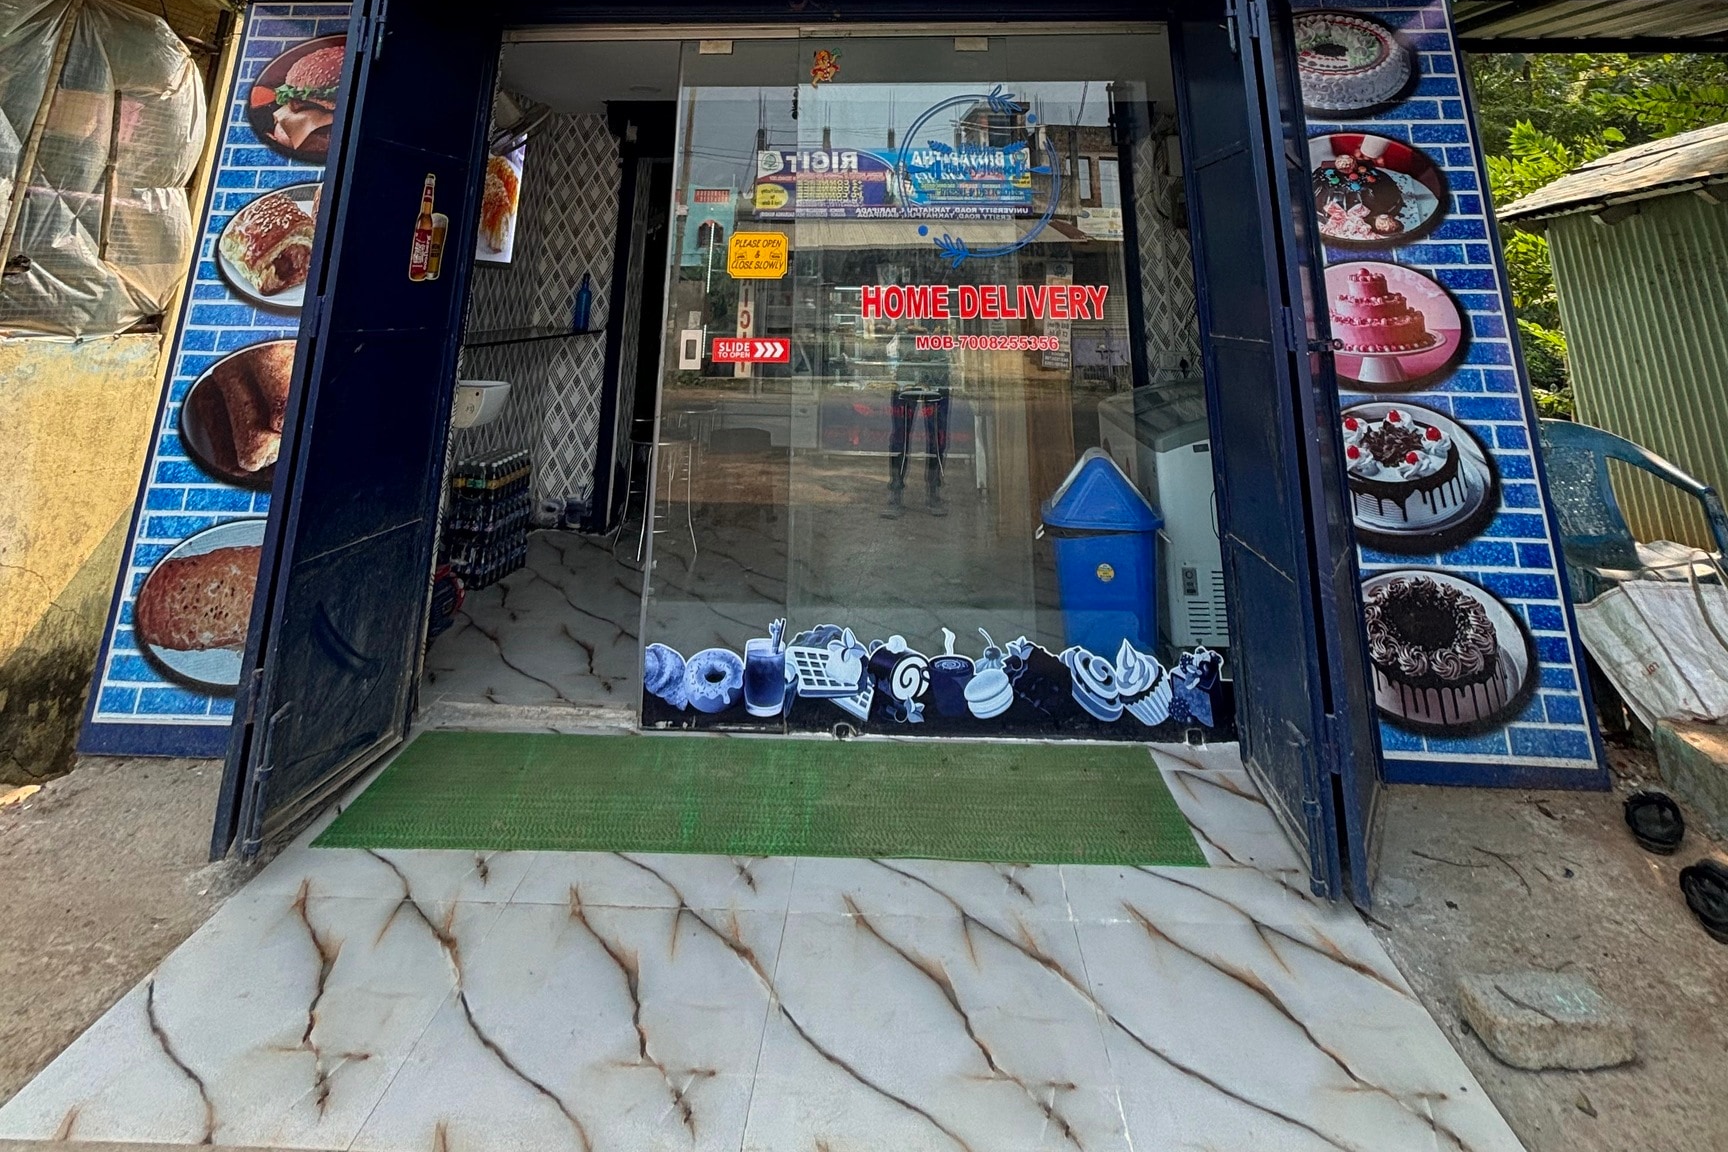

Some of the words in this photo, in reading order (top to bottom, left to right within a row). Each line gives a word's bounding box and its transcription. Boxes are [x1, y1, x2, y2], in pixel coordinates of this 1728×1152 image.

[734, 239, 761, 248] PLEASE
[762, 239, 782, 248] OPEN
[754, 250, 761, 259] &
[731, 260, 754, 269] CLOSE
[754, 260, 784, 269] SLOWLY
[861, 285, 950, 320] HOME
[958, 285, 1109, 320] DELIVERY
[718, 342, 751, 352] SLIDE
[915, 334, 1060, 351] MOB-7008255356
